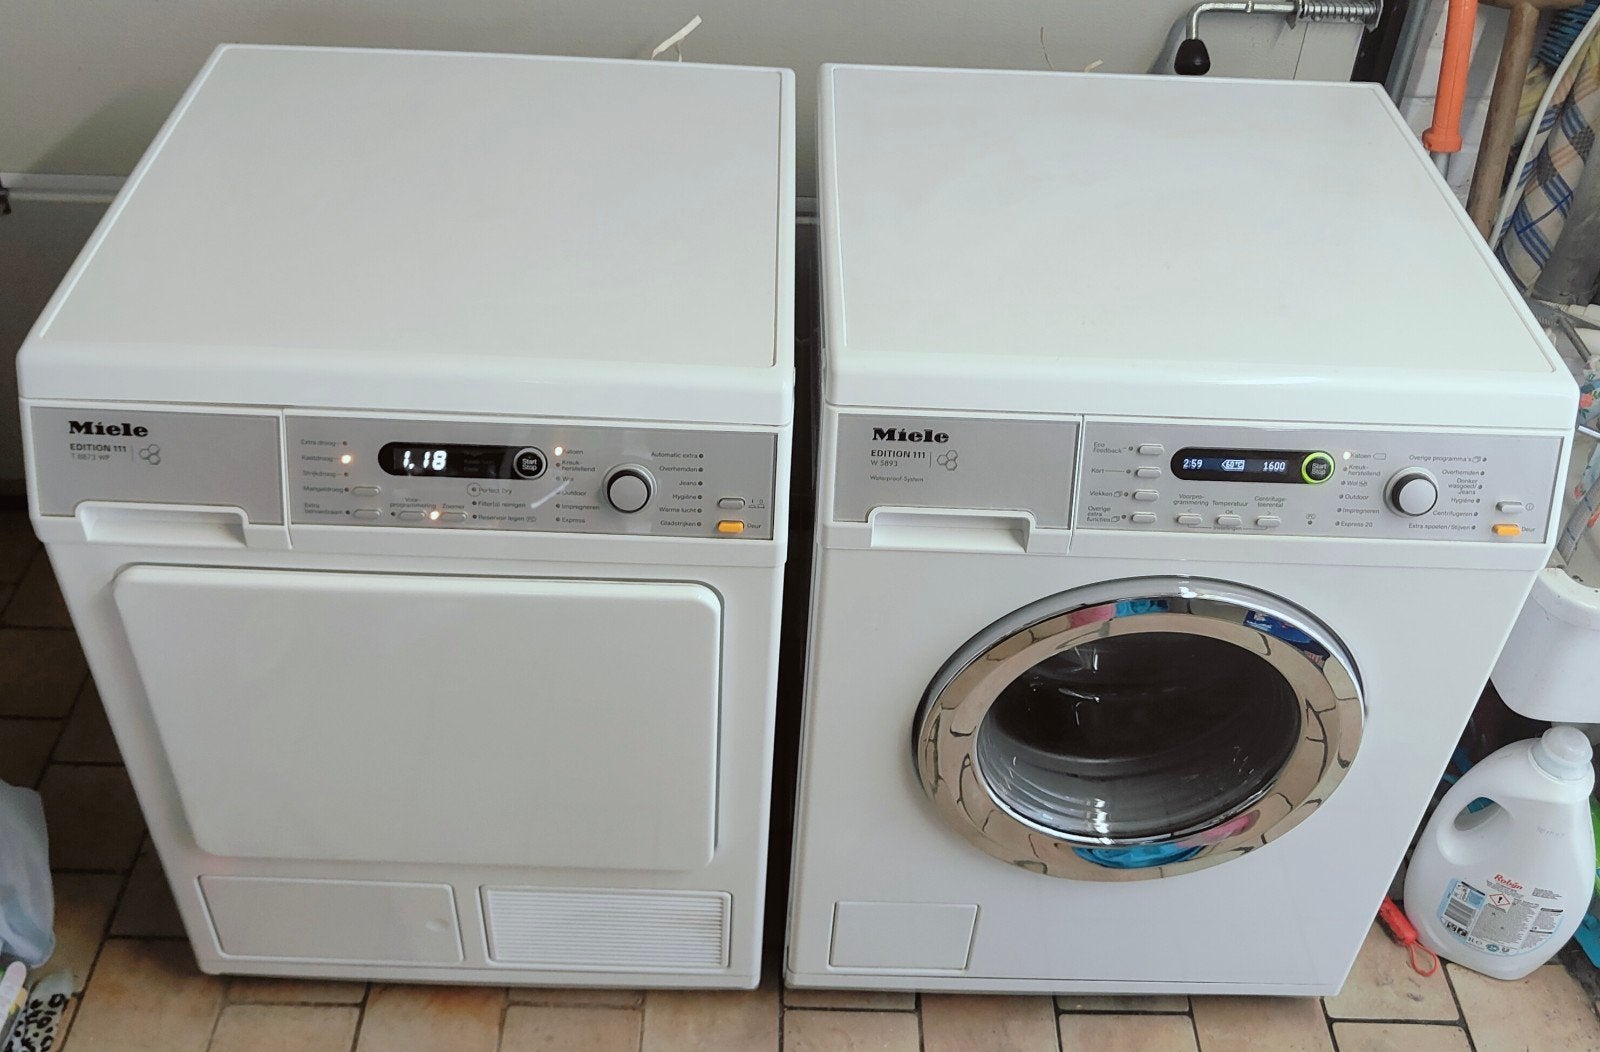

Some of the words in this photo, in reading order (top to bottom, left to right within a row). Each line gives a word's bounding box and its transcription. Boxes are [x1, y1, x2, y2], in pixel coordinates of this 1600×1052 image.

[68, 420, 149, 437] Miele
[872, 427, 949, 443] Miele
[70, 443, 110, 452] EDITION
[871, 449, 910, 458] EDITION
[913, 451, 926, 459] 111
[1182, 458, 1203, 470] 2:59
[1262, 461, 1286, 472] 1600
